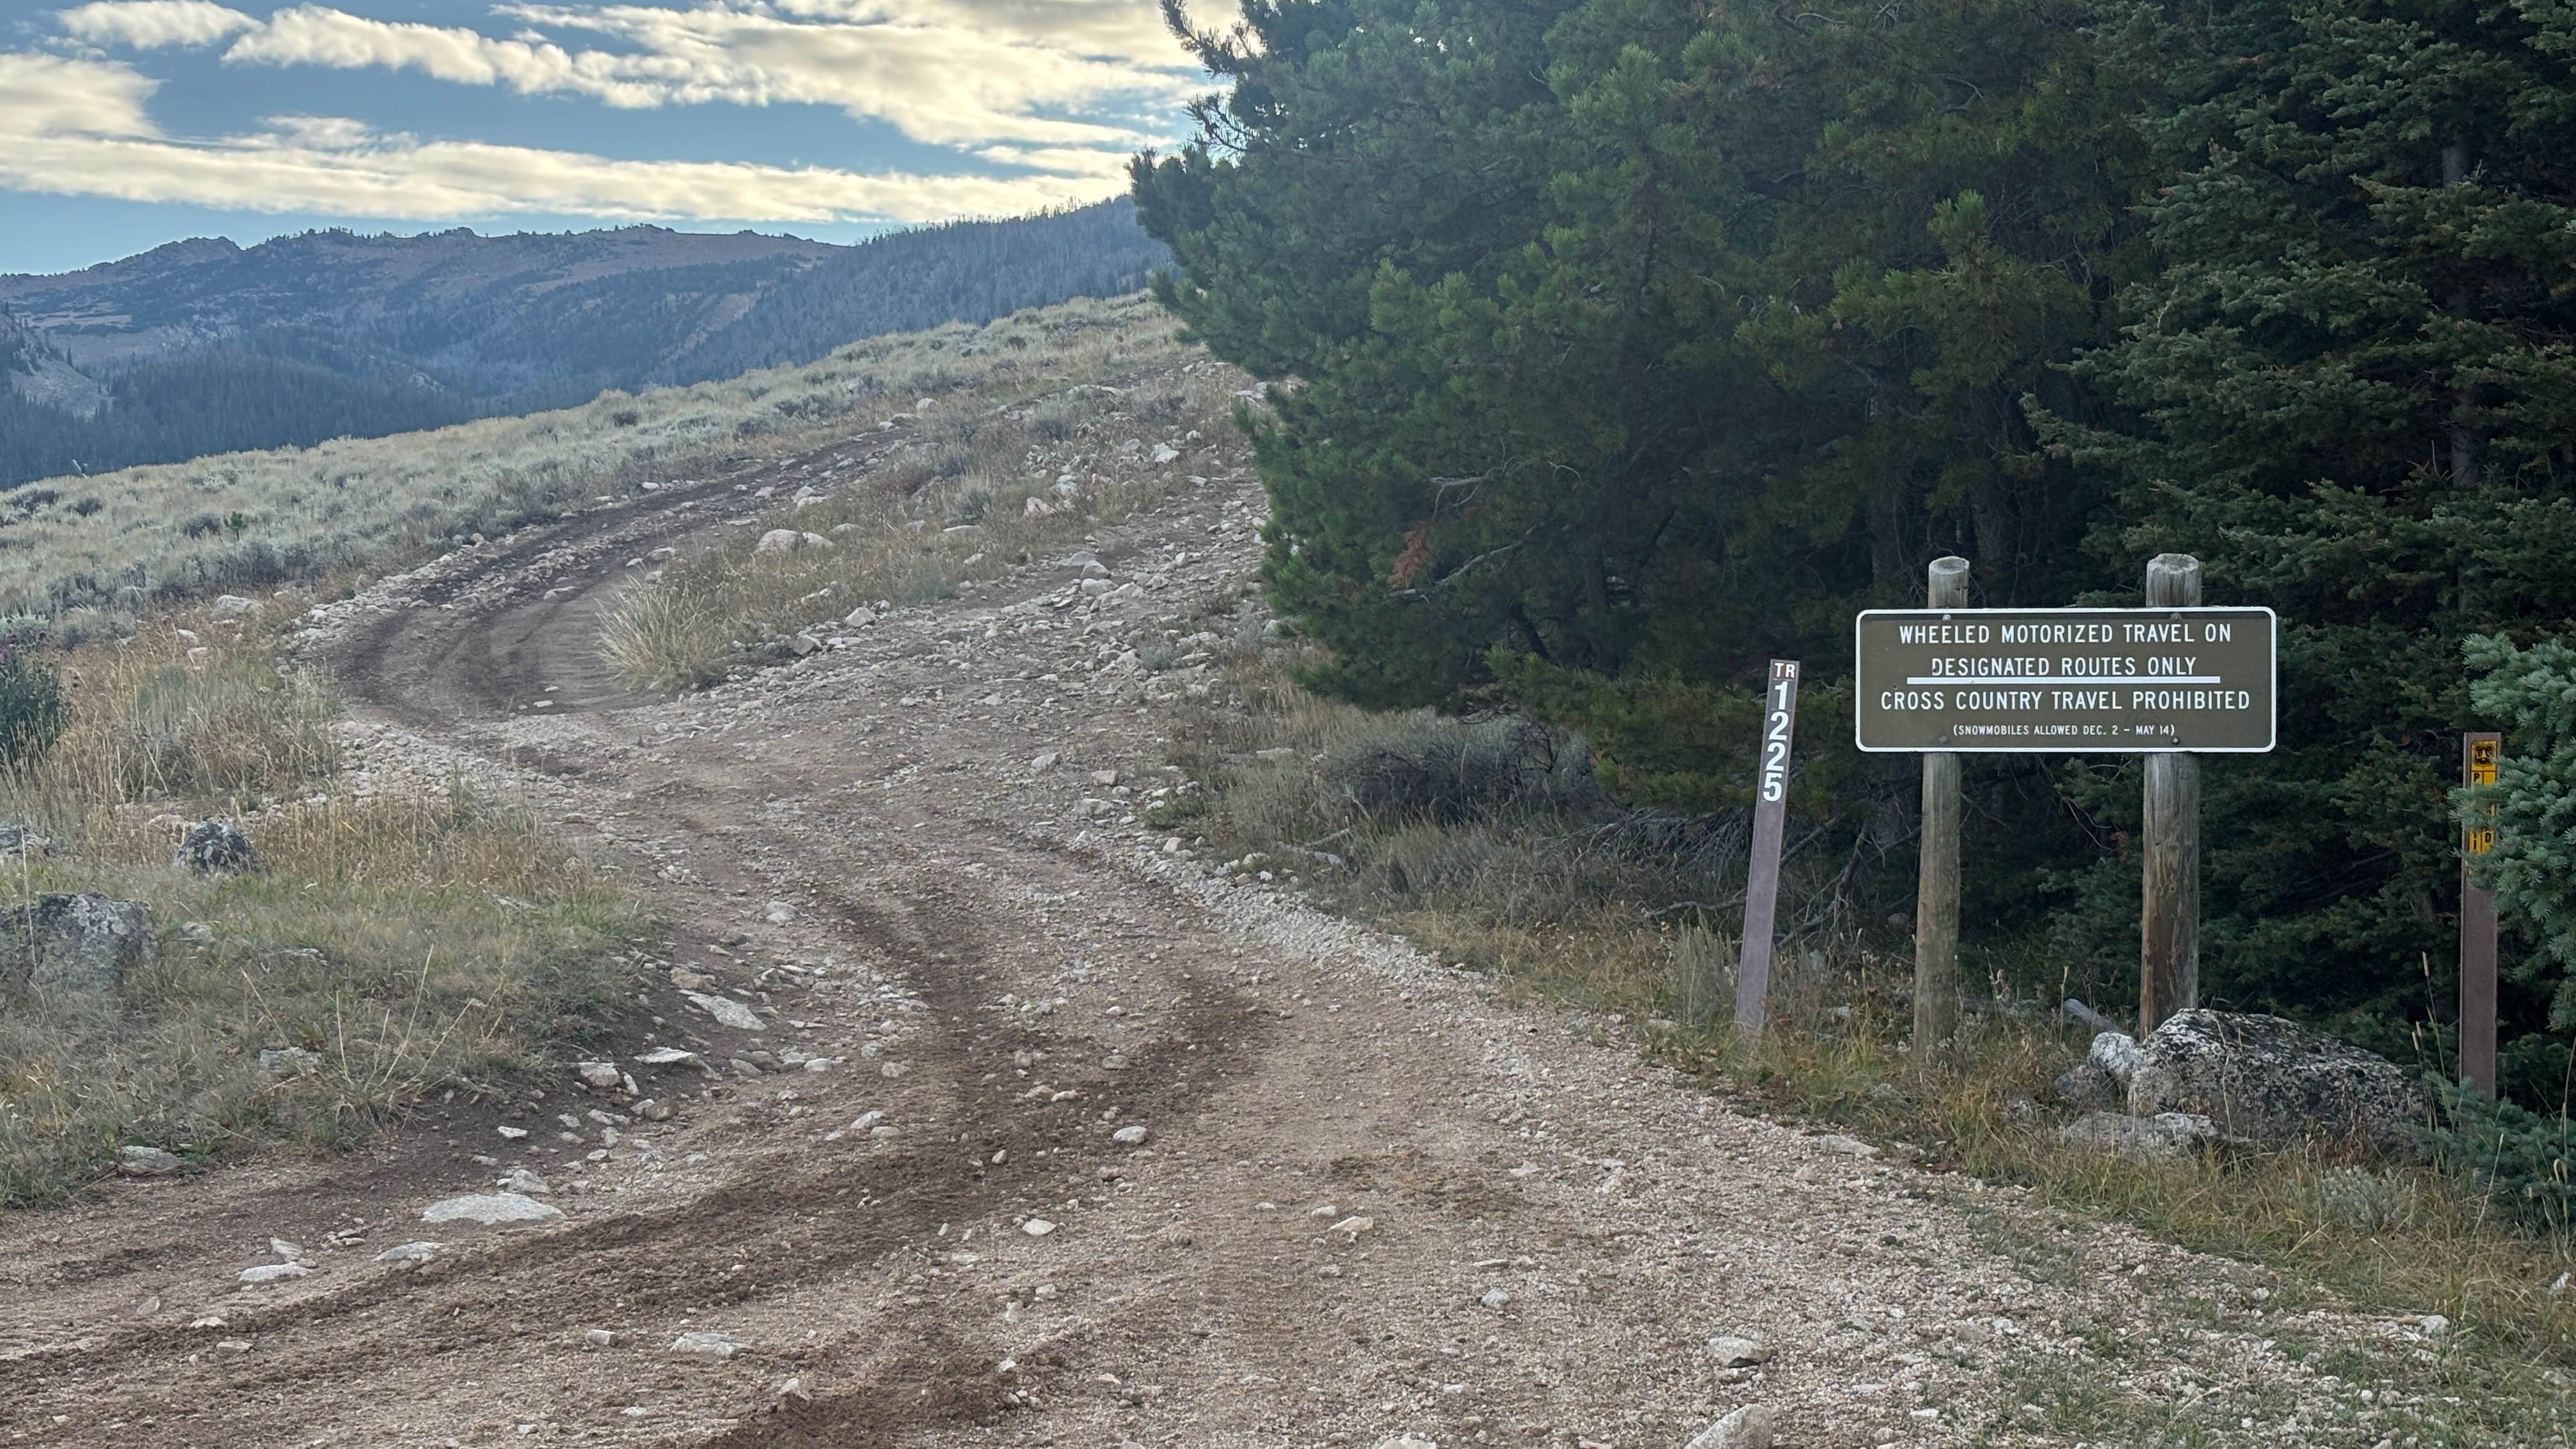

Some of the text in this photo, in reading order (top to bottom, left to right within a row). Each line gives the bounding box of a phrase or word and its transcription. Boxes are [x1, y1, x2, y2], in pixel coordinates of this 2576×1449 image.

[1899, 623, 2231, 644] WHEELED MOTORIZED TRAVEL ON
[1774, 663, 1795, 678] TR
[1932, 656, 2196, 676] DESIGNATED ROUTES ONLY
[1881, 691, 2250, 710] CROSS COUNTRY TRAVEL PROHIBITED
[1953, 724, 2030, 737] (SNOWMOBILES
[2034, 724, 2078, 735] ALLOWED
[2083, 724, 2106, 735] DEC.
[2112, 724, 2119, 735] 2
[2135, 724, 2155, 735] MAY
[2159, 724, 2175, 737] 14)
[1763, 681, 1789, 802] 1225
